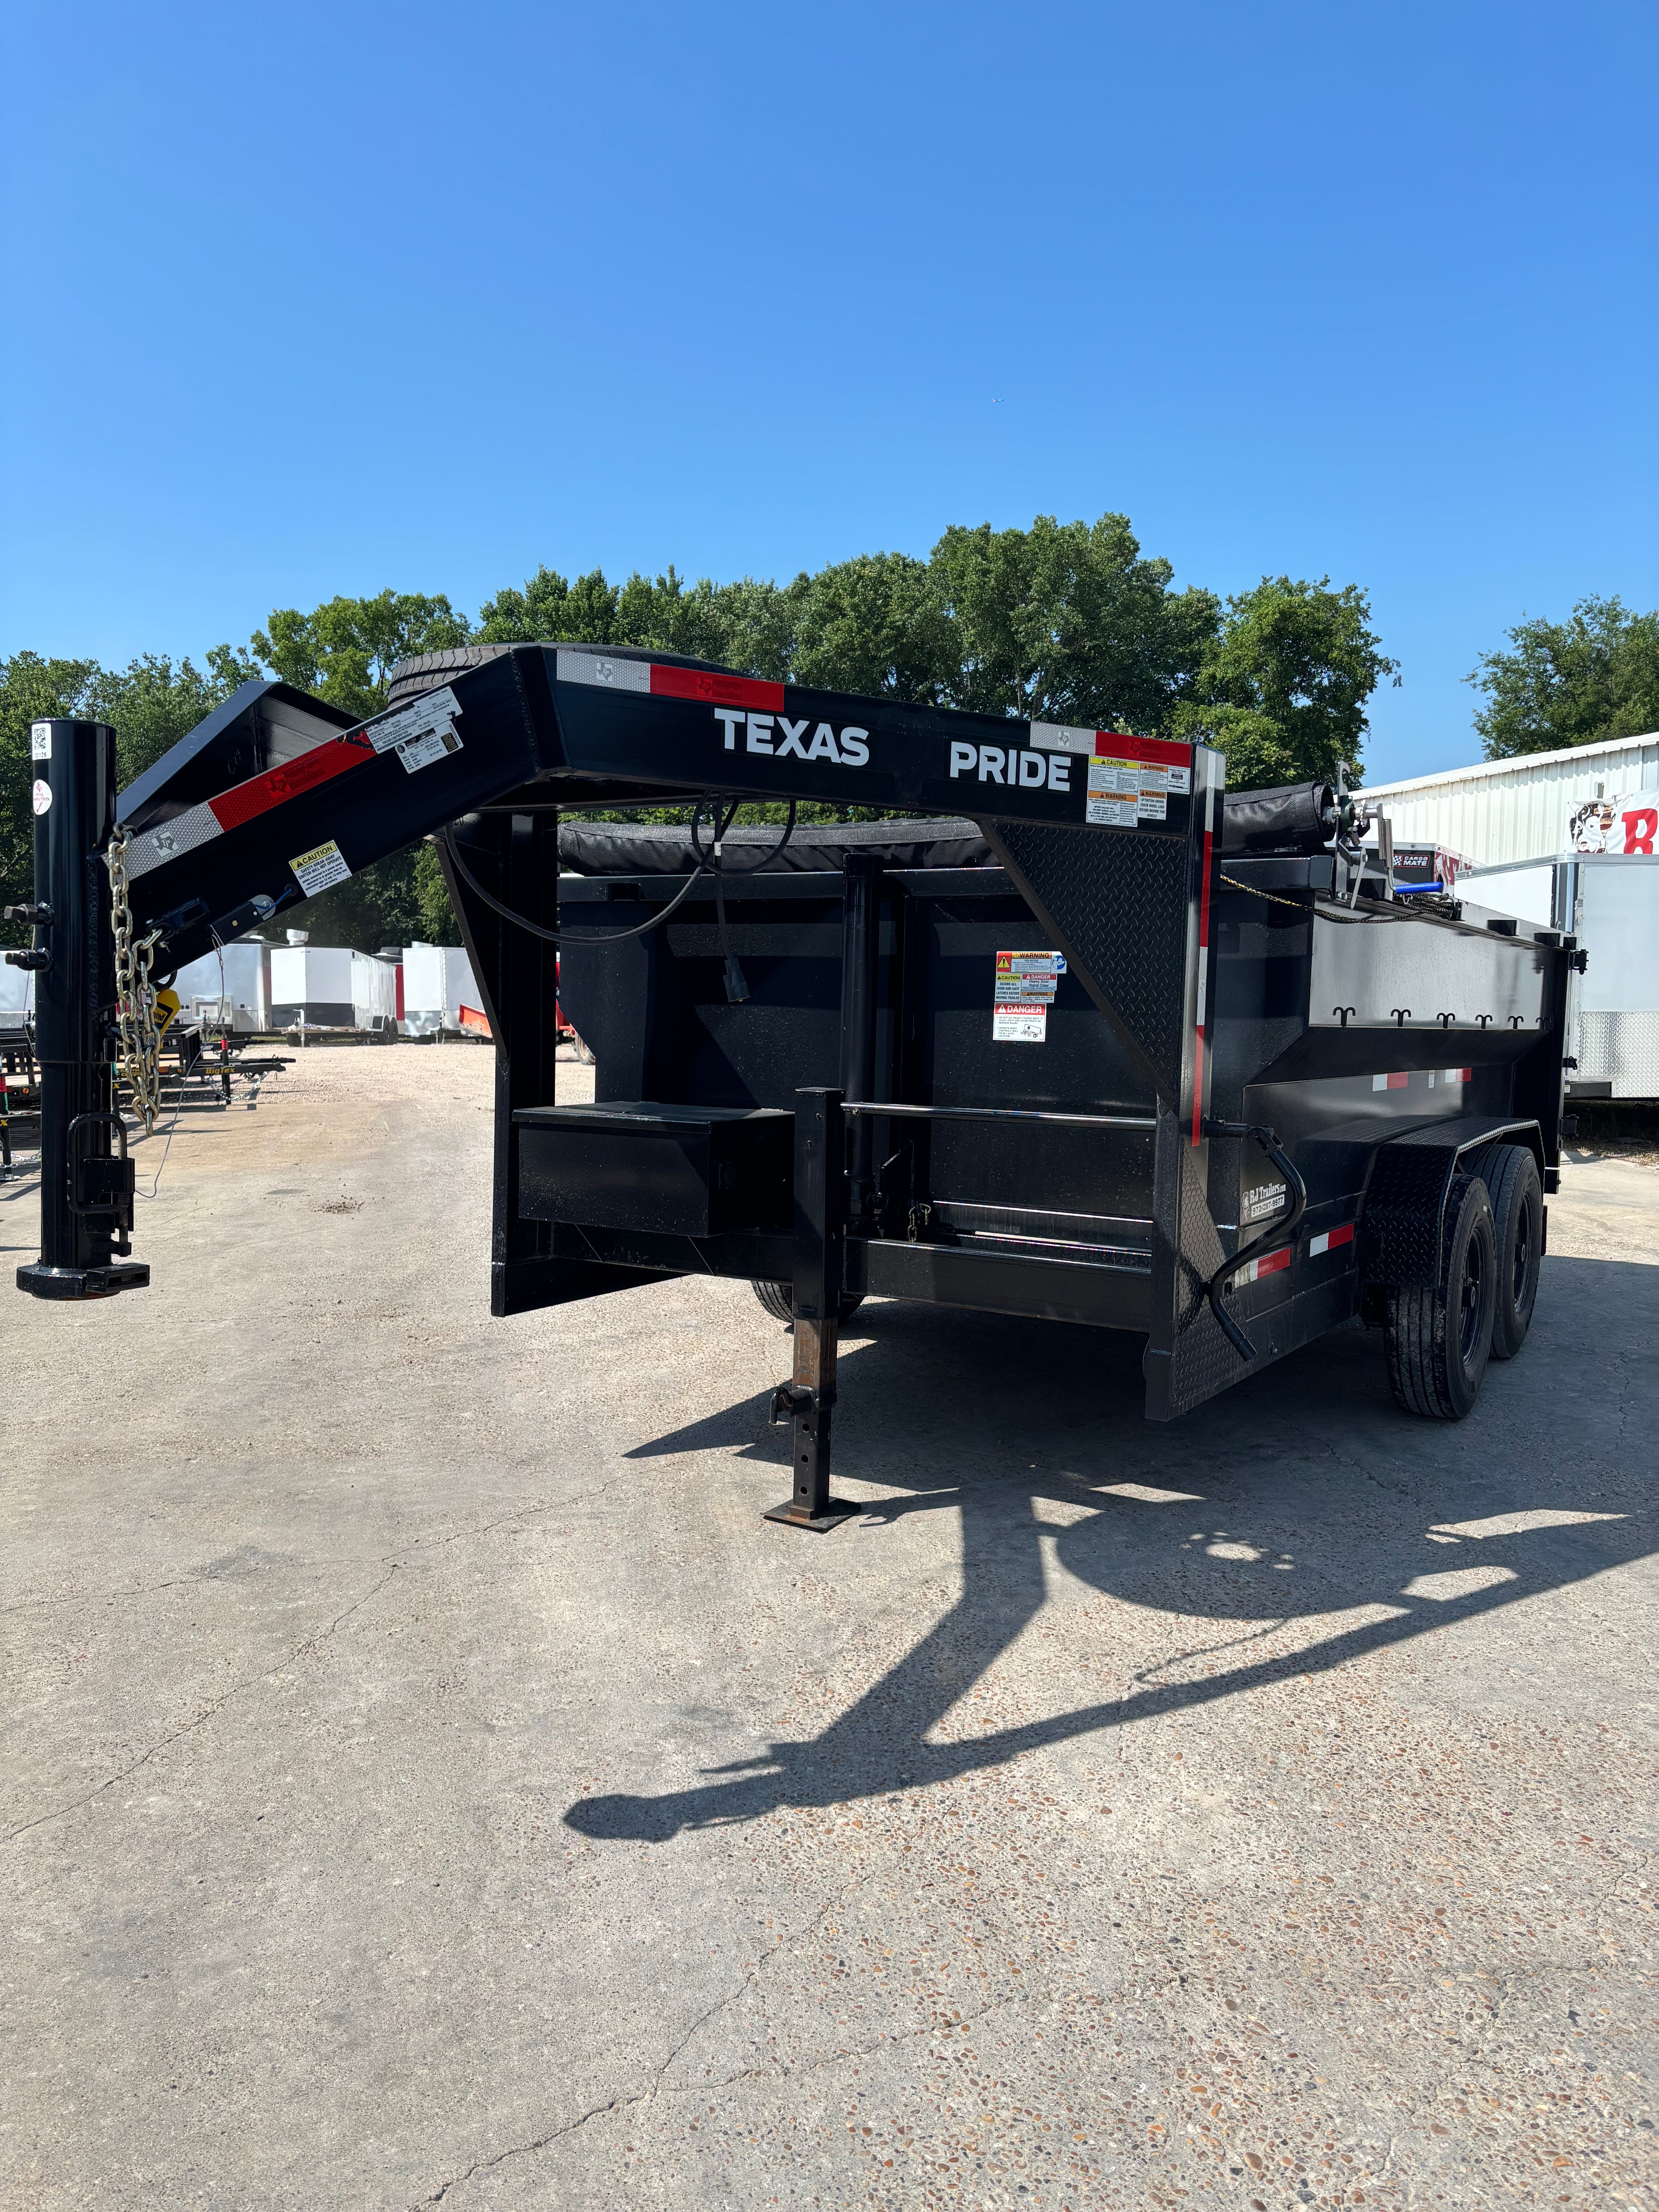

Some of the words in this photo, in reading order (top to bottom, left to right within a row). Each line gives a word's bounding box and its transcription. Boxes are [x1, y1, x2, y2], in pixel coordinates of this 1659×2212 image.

[714, 708, 869, 766] TEXAS
[950, 741, 1071, 792] PRIDE
[302, 845, 333, 864] CAUTION
[298, 871, 312, 880] SWITCH
[327, 856, 342, 866] OPERATE
[301, 865, 314, 874] SAFETY
[1007, 1005, 1042, 1013] DANGER
[1250, 1188, 1259, 1204] RJ
